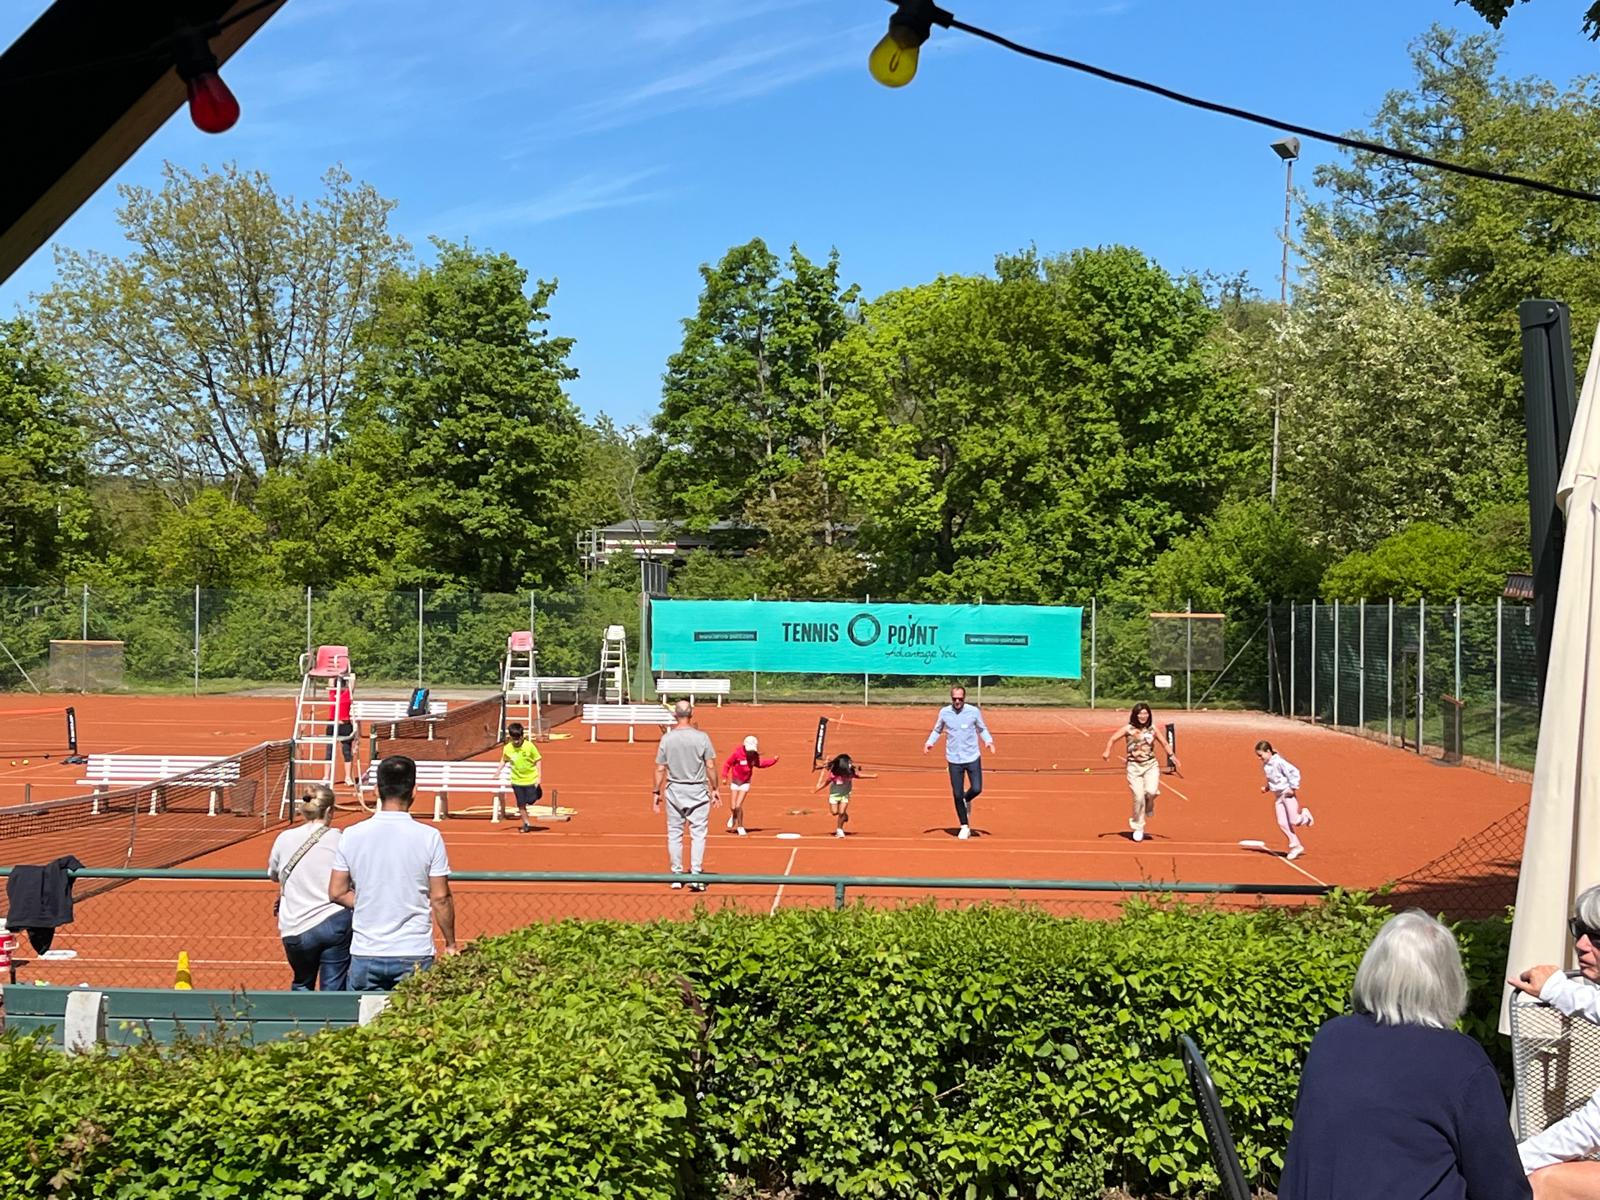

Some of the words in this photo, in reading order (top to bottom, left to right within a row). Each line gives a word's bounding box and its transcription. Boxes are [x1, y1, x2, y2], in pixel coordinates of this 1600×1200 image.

[781, 622, 840, 643] TENNIS
[887, 617, 939, 646] POINT
[939, 645, 957, 658] You
